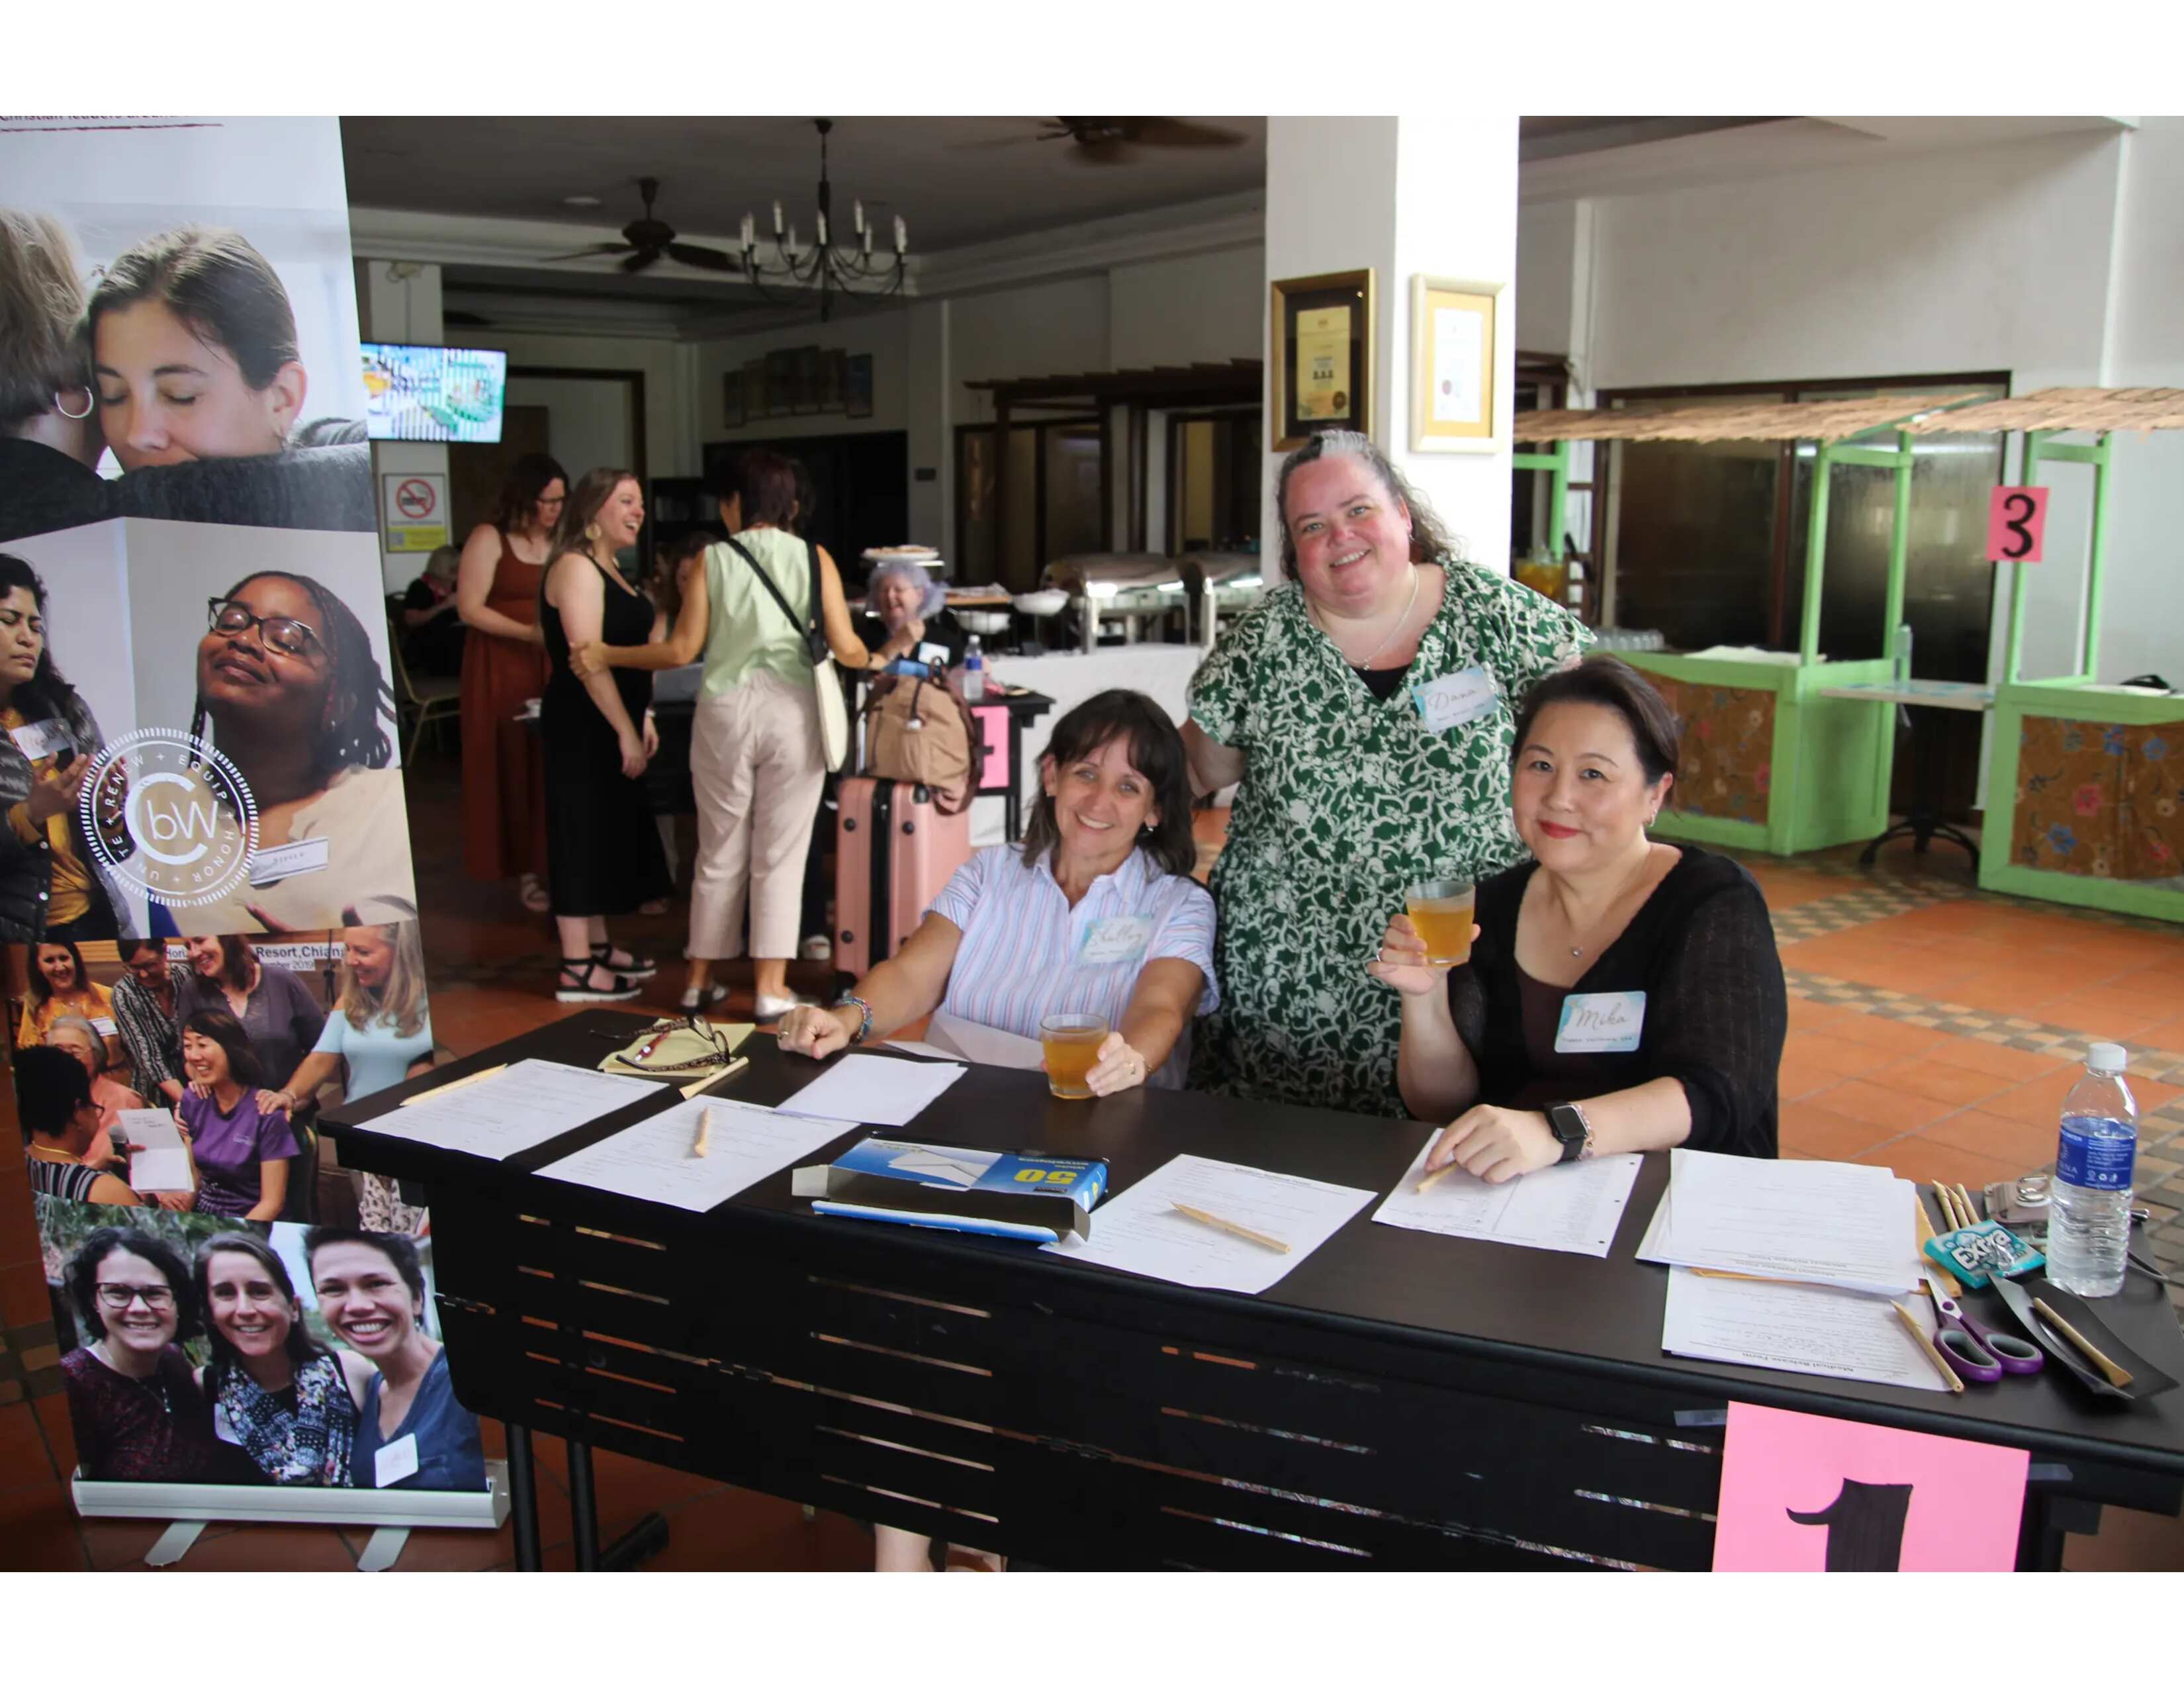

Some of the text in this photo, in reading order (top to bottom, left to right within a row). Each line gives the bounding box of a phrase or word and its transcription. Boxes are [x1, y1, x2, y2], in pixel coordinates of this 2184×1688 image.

[2002, 493, 2036, 557] 3
[178, 754, 228, 800] EQUIP
[191, 829, 235, 882] HONOR
[1014, 1169, 1078, 1185] 50
[1771, 1356, 1810, 1366] Release
[1812, 1362, 1854, 1372] Medical
[1786, 1477, 1914, 1572] 1
